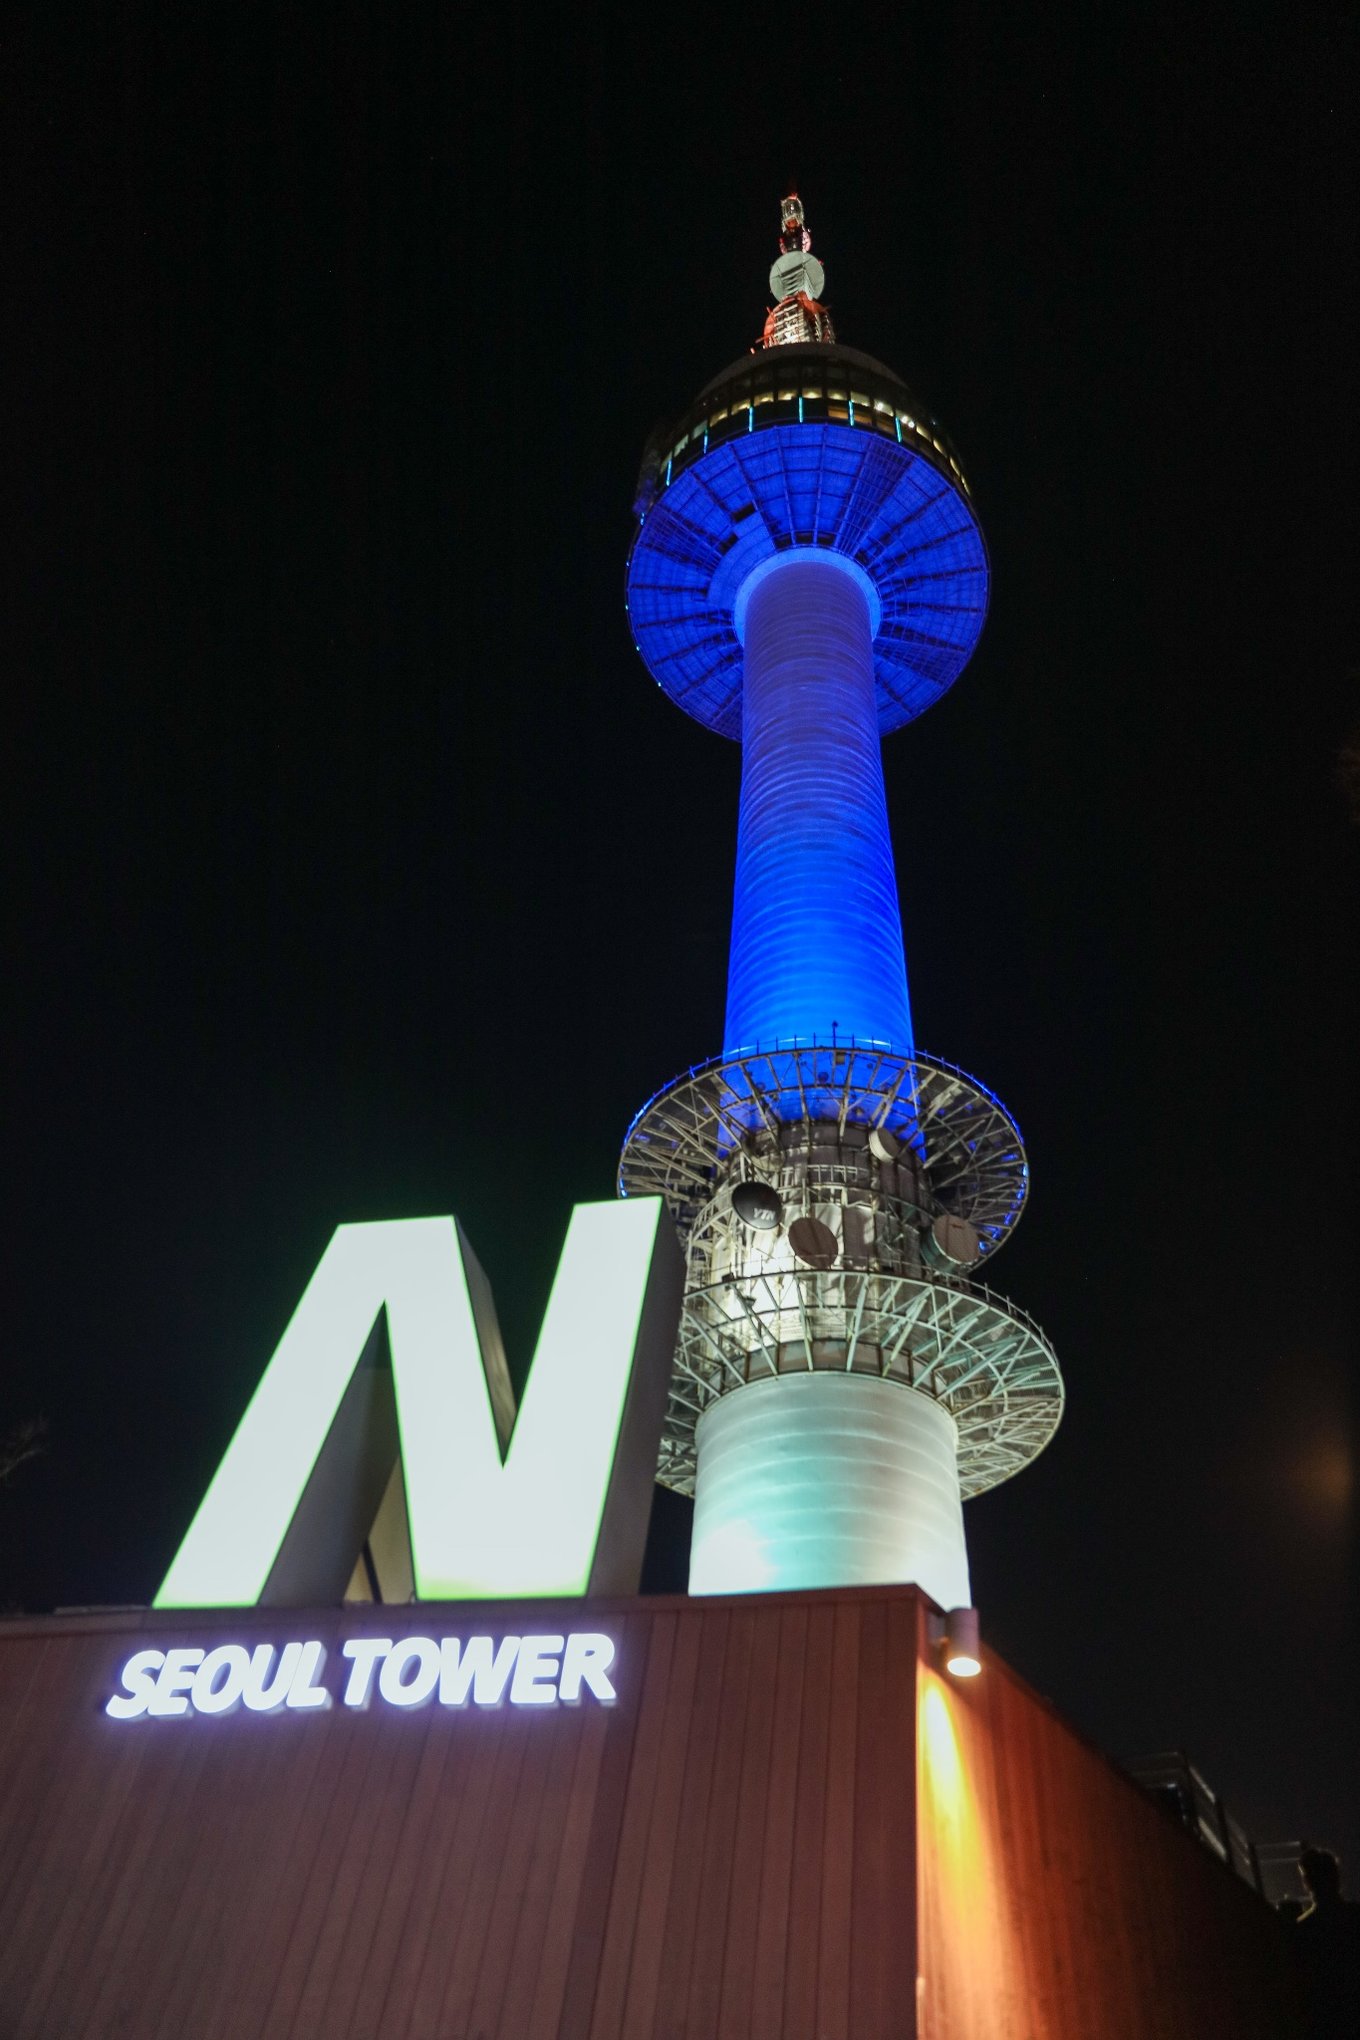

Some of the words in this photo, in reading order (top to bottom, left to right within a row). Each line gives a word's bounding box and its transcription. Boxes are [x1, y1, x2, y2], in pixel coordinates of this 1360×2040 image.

[753, 1207, 776, 1221] YTN
[153, 1196, 662, 1609] N
[106, 1641, 328, 1719] SEOUL
[343, 1633, 617, 1706] TOWER
